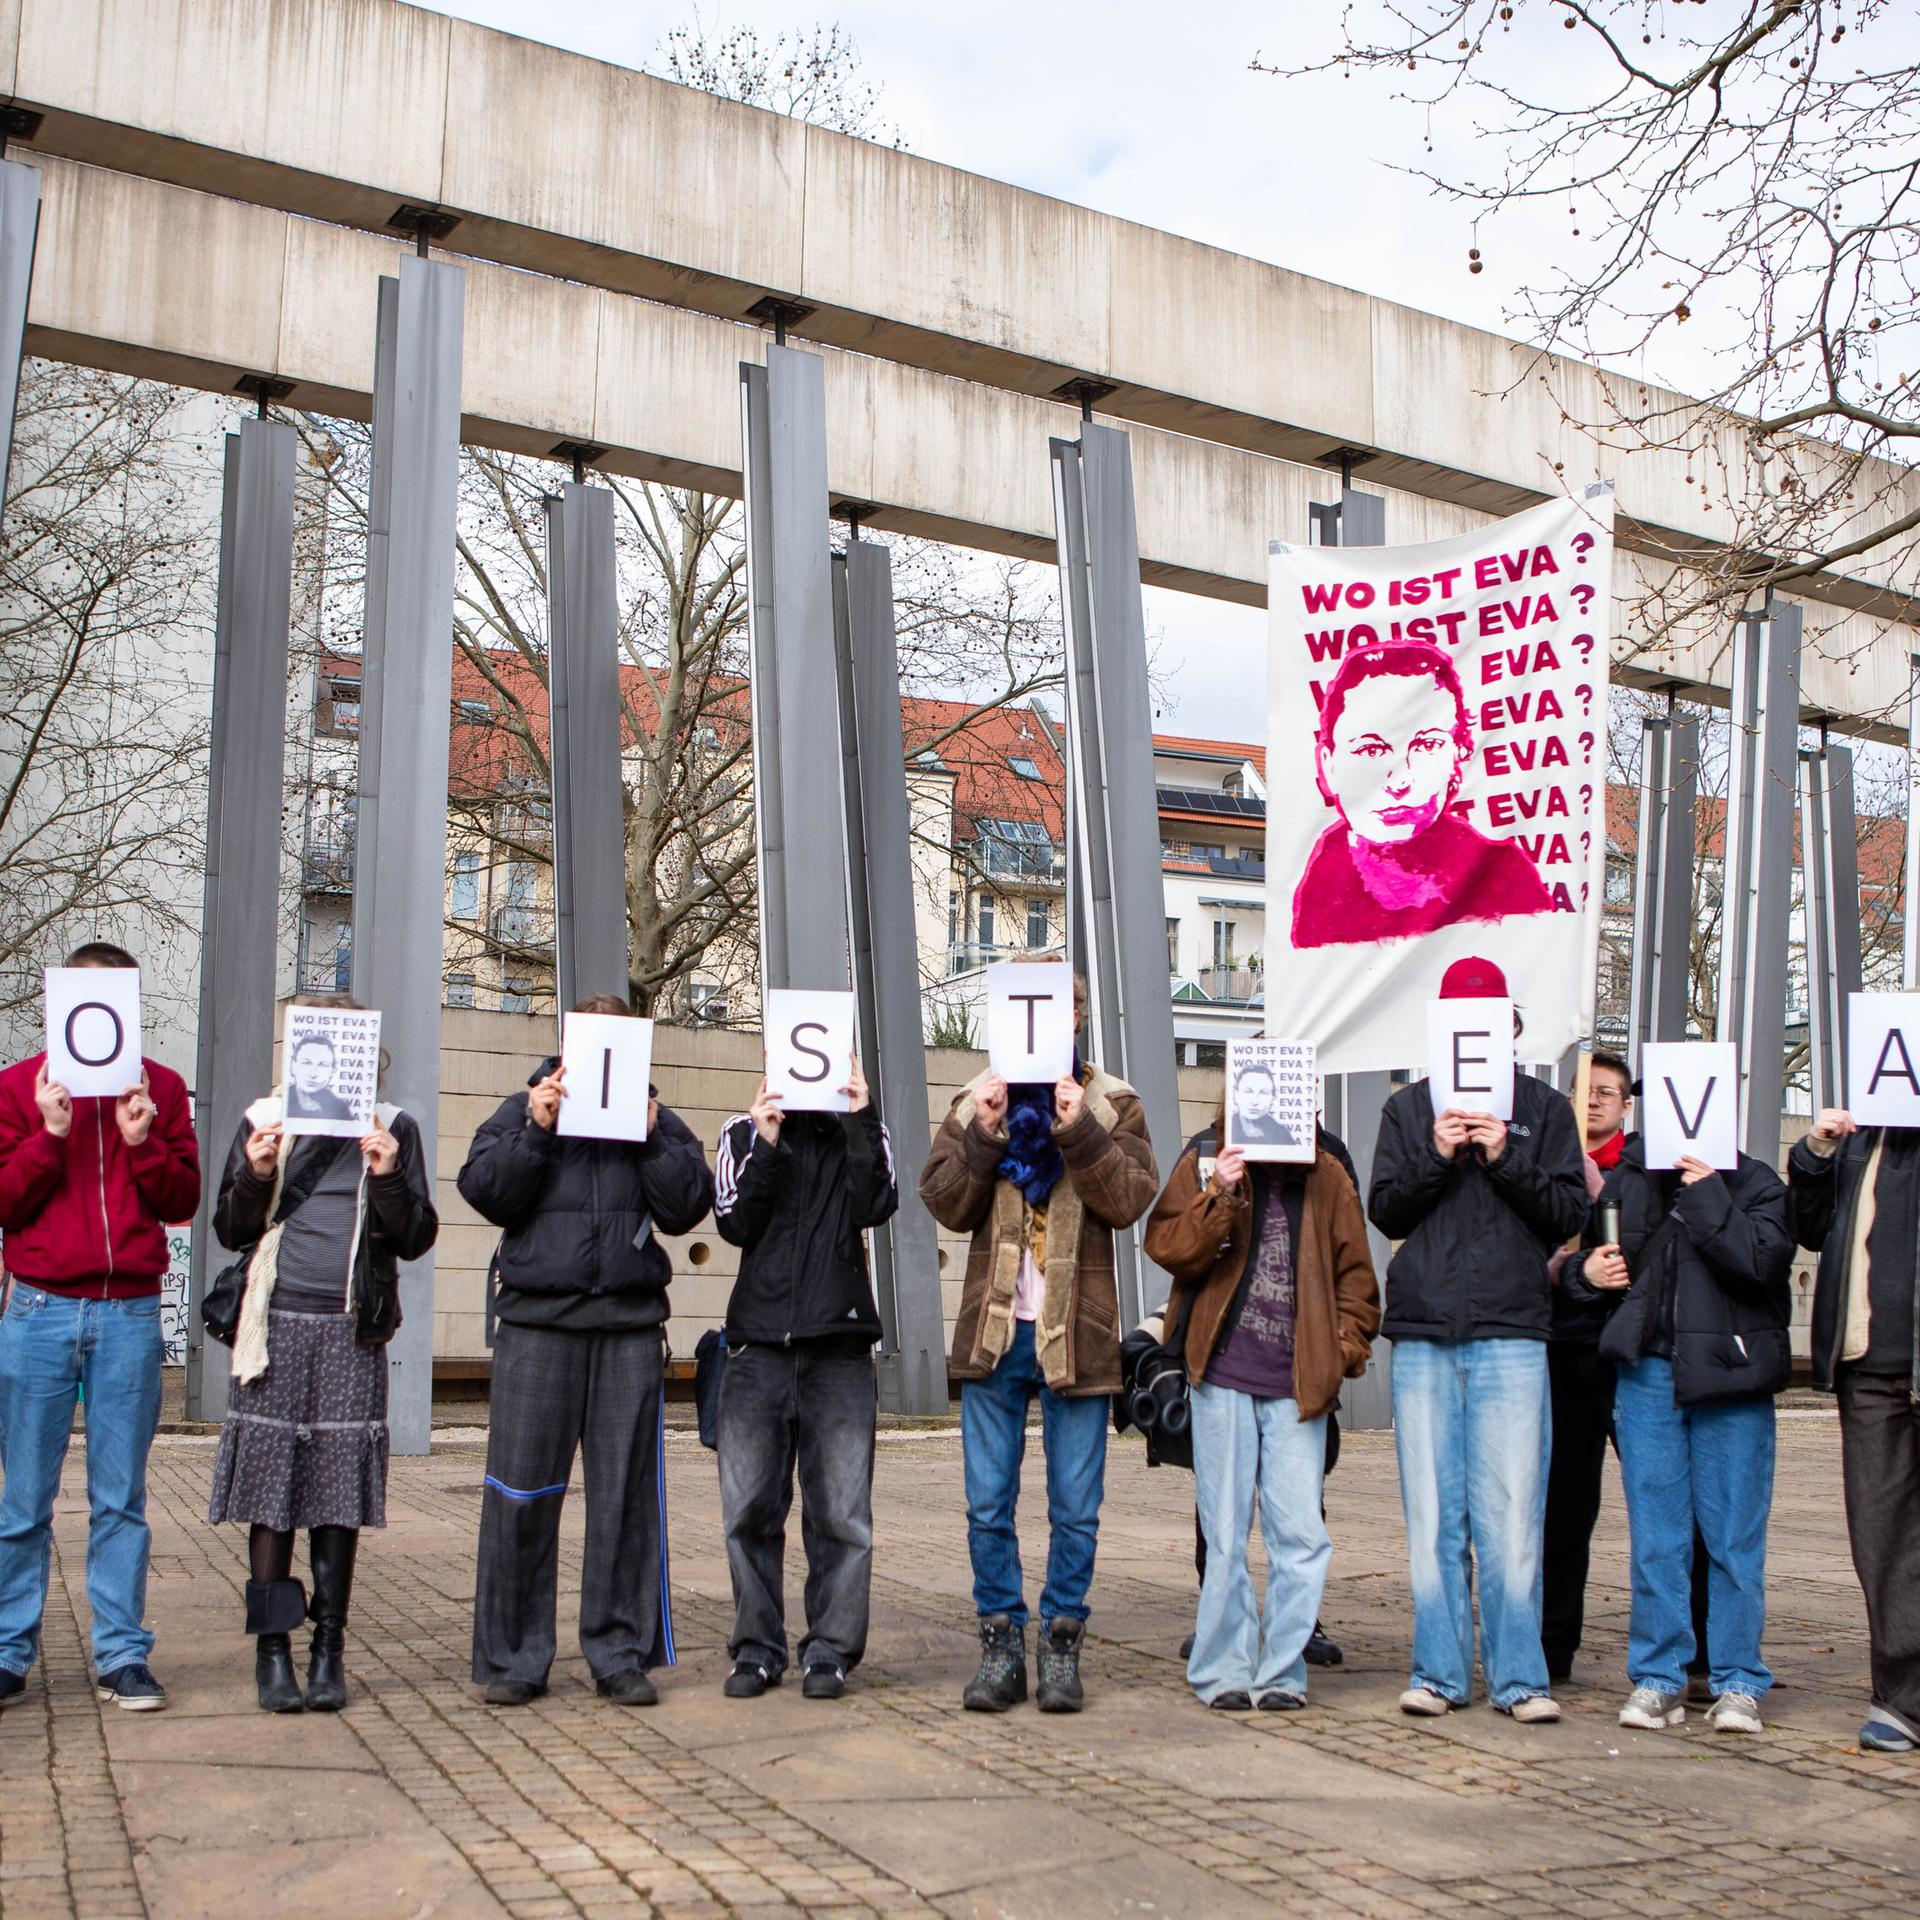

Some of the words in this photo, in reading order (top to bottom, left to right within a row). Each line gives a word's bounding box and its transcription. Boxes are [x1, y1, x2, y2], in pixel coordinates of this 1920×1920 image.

[1302, 582, 1375, 614] WO
[1389, 568, 1461, 606] IST
[1474, 544, 1560, 589] EVA
[1570, 532, 1595, 564] ?
[1304, 624, 1379, 662] WO
[1391, 611, 1466, 645] IST
[1479, 593, 1560, 637] EVA
[1570, 584, 1595, 615] ?
[1481, 640, 1561, 685] EVA
[1571, 633, 1594, 664] ?
[1481, 689, 1564, 731] EVA
[1575, 683, 1592, 717] ?
[1483, 736, 1570, 776] EVA
[1578, 731, 1594, 764] ?
[1487, 786, 1570, 828] EVA
[1579, 784, 1592, 815] ?
[1510, 833, 1572, 864] VA
[1580, 831, 1591, 862] ?
[65, 1001, 124, 1067] O
[293, 1015, 314, 1024] WO
[318, 1016, 339, 1026] IST
[343, 1018, 367, 1027] EVA
[342, 1031, 366, 1041] EVA
[1009, 995, 1053, 1054] T
[340, 1059, 364, 1068] EVA
[341, 1045, 365, 1055] EVA
[788, 1022, 831, 1083] S
[1233, 1046, 1253, 1055] WO
[1257, 1046, 1277, 1055] IST
[1280, 1046, 1303, 1055] EVA
[1280, 1060, 1303, 1068] EVA
[1453, 1031, 1492, 1093] E
[1868, 1029, 1920, 1095] A
[338, 1085, 362, 1095] EVA
[339, 1071, 363, 1081] EVA
[1280, 1073, 1302, 1081] EVA
[1280, 1086, 1302, 1094] EVA
[1279, 1112, 1302, 1120] EVA
[1280, 1099, 1302, 1107] EVA
[1663, 1077, 1717, 1140] V
